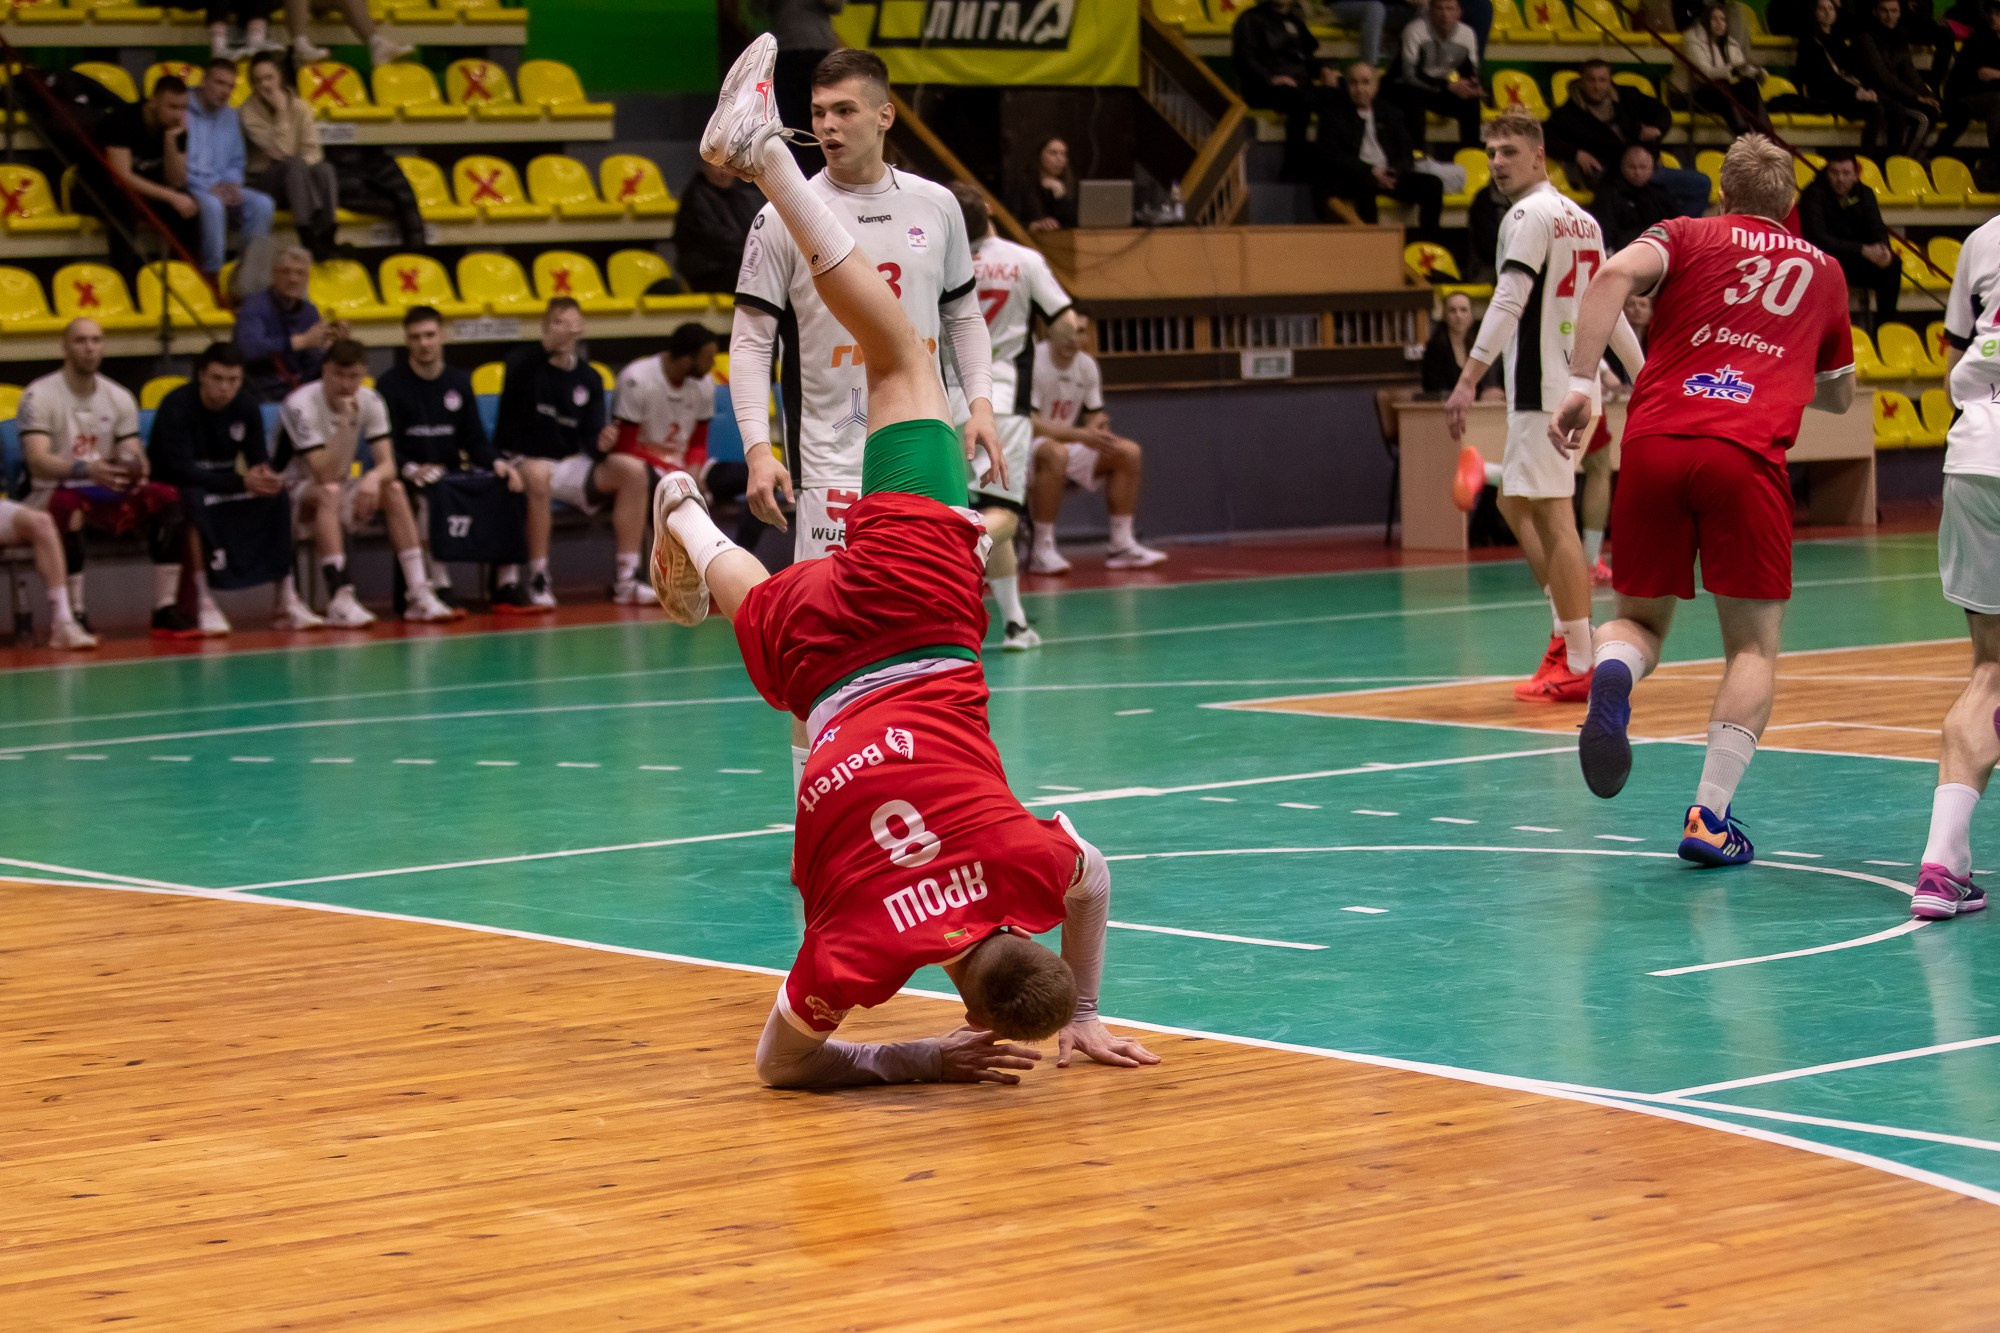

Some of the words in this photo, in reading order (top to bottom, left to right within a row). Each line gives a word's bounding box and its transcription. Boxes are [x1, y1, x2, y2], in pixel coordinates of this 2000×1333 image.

[857, 214, 892, 224] Kempa
[1731, 226, 1827, 266] ПИЛЮК
[1555, 249, 1600, 298] 47
[1723, 255, 1814, 317] 30
[1714, 327, 1786, 358] BelFert
[800, 743, 885, 813] BelFert
[870, 799, 942, 868] 8
[882, 861, 988, 934] ЯРОШ
